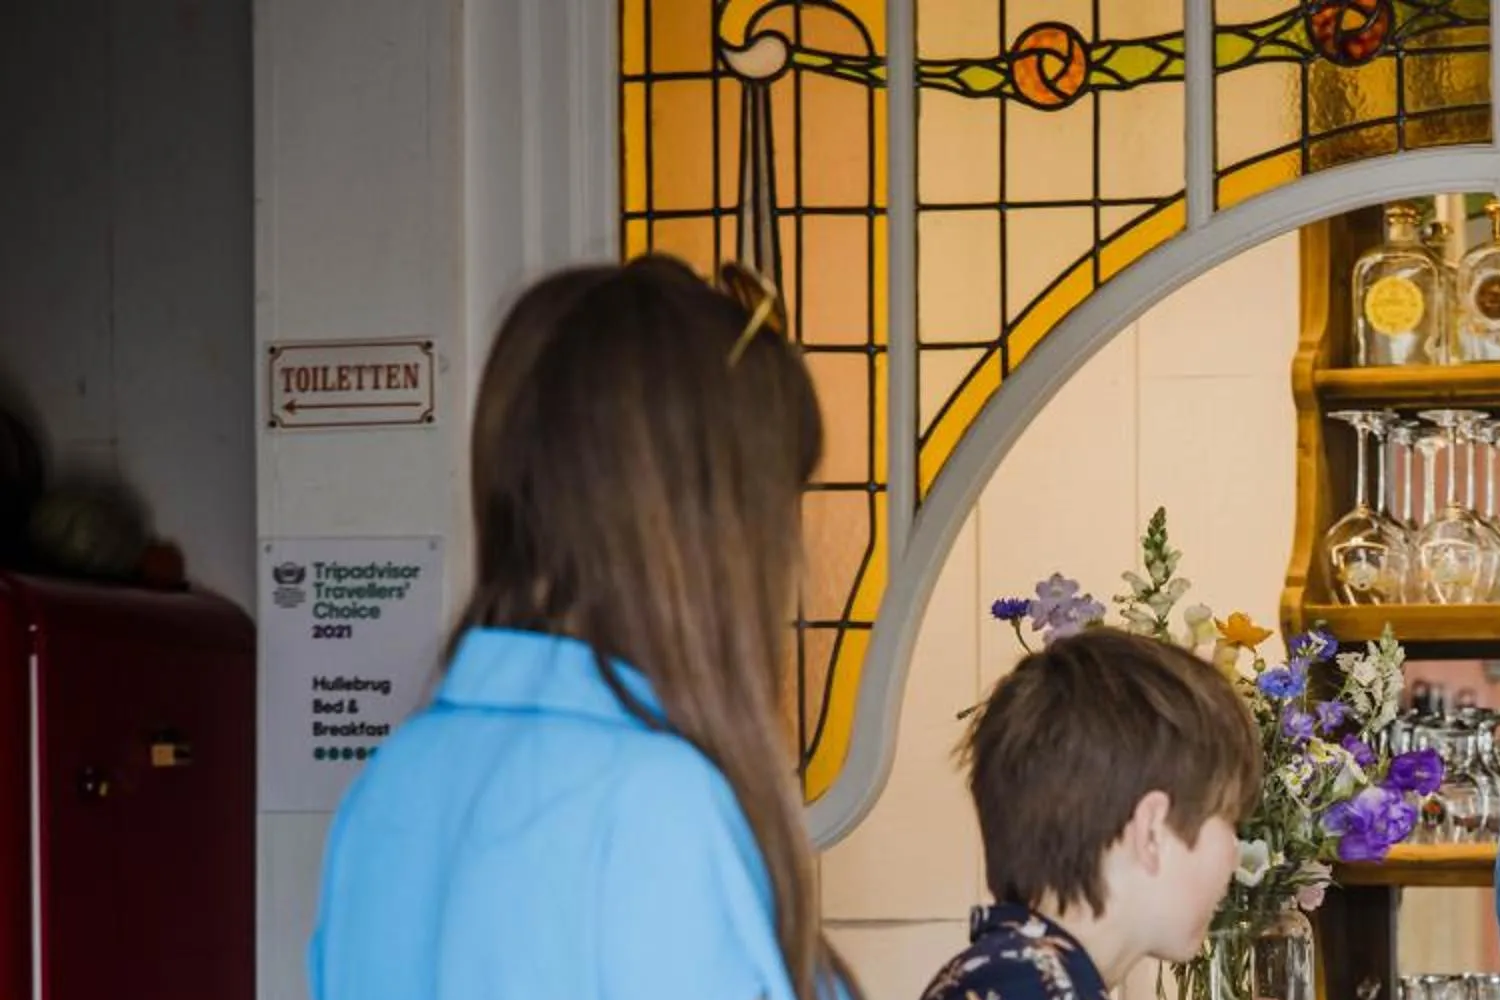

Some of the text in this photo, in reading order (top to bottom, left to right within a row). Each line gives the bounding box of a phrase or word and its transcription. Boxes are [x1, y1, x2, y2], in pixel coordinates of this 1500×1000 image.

[281, 363, 420, 393] TOILETTEN
[313, 561, 421, 582] Tripadvisor
[313, 602, 381, 619] Choice
[312, 625, 352, 639] 2021
[312, 677, 392, 695] Hullebrug
[313, 699, 359, 714] Bed &
[312, 722, 391, 736] Breakfast
